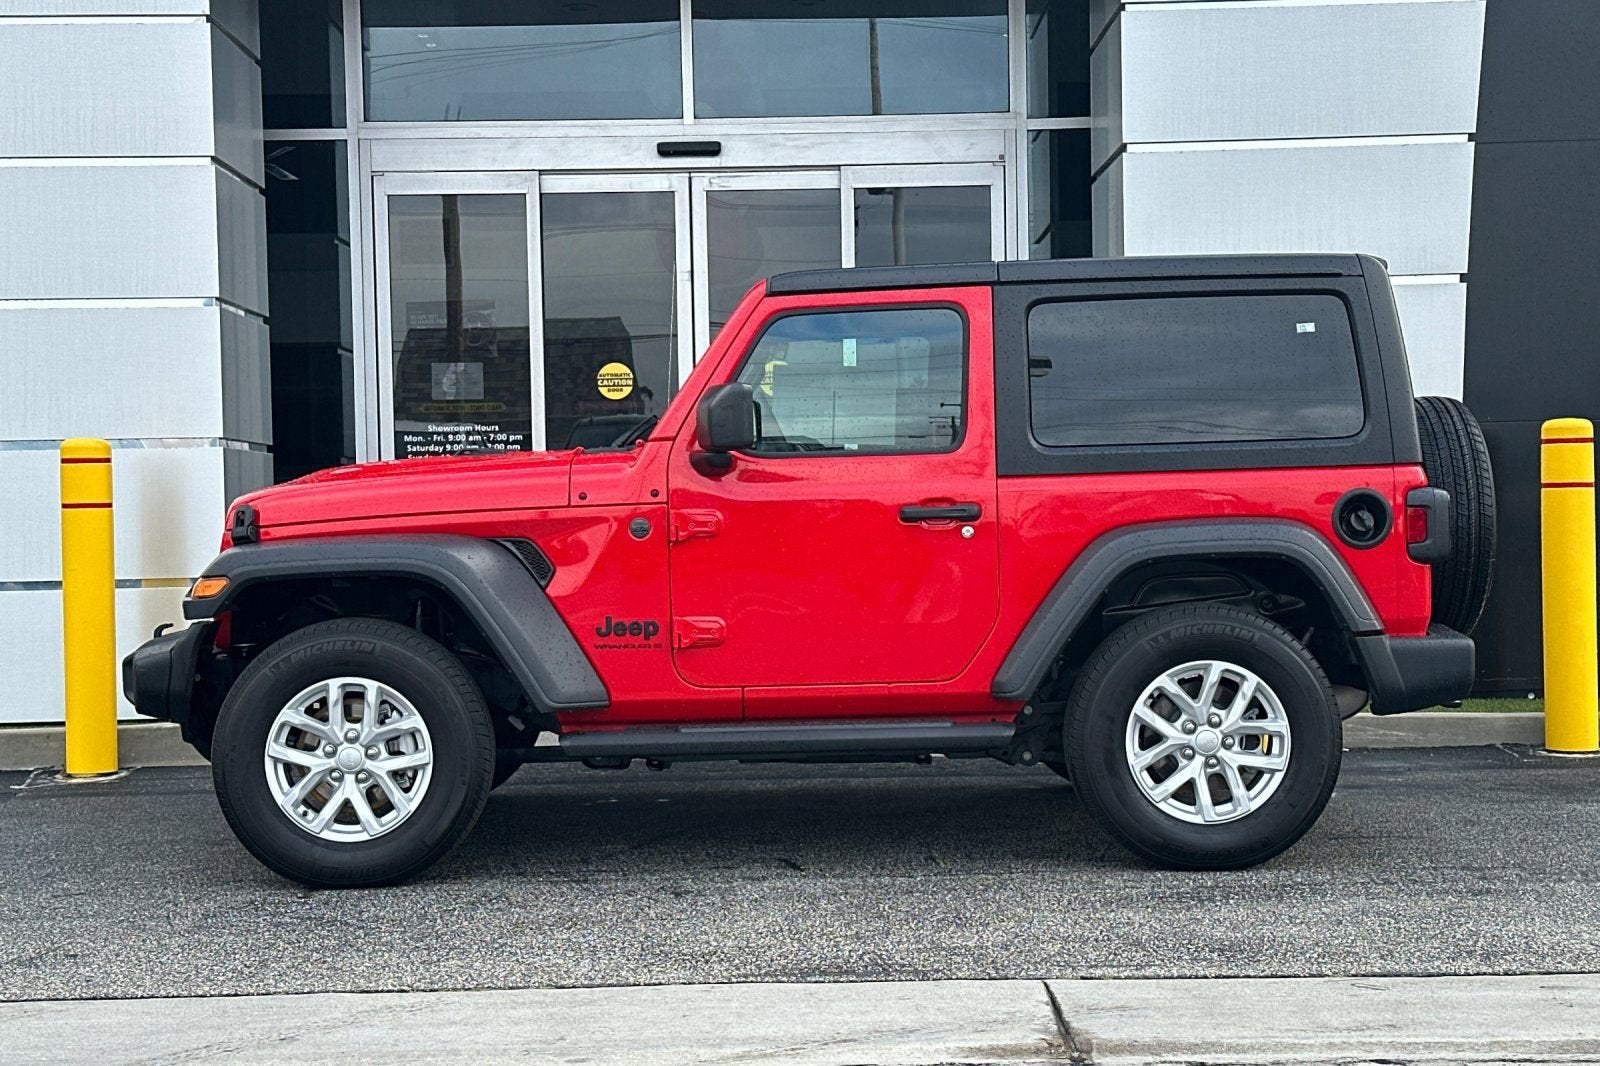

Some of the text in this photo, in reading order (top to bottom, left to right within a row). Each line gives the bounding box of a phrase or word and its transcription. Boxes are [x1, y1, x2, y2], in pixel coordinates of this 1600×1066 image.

[427, 424, 473, 432] Showroom
[433, 434, 446, 442] Fri.
[489, 433, 507, 441] 7:00
[509, 434, 523, 442] pm
[407, 444, 444, 452] Saturday
[595, 615, 660, 641] Jeep
[1169, 623, 1256, 642] MICHELIN
[290, 639, 377, 661] MICHELIN
